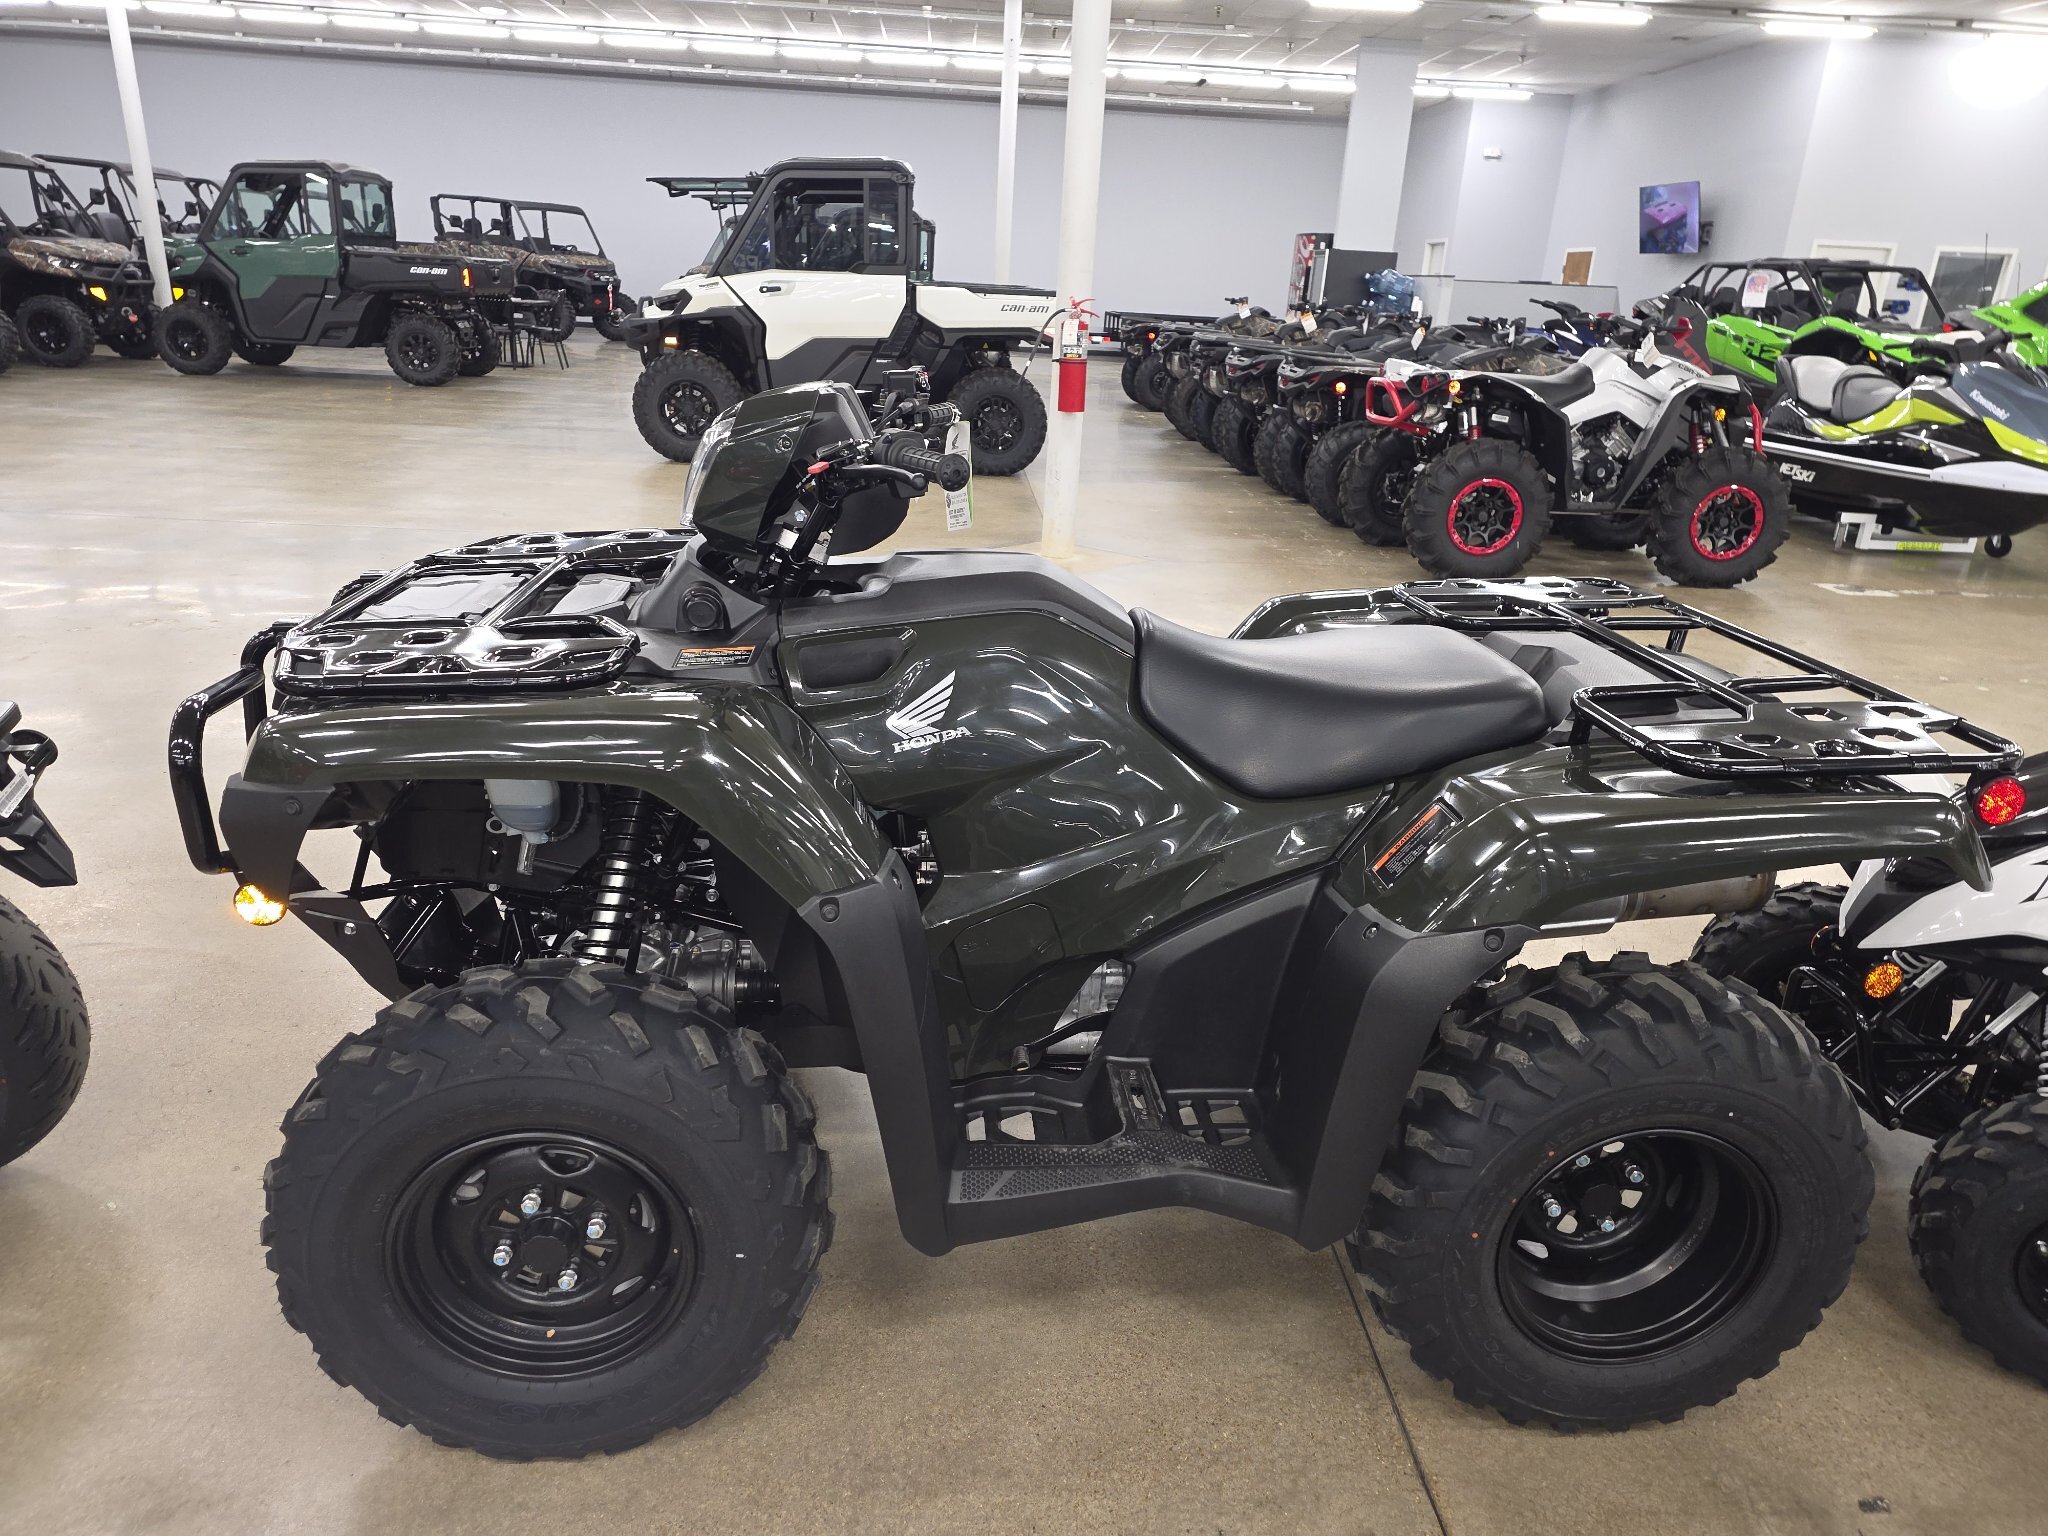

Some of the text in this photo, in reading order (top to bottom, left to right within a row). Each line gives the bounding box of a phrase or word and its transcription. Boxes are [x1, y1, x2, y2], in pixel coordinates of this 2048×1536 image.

[1000, 304, 1050, 313] can-am
[892, 726, 972, 754] HONDA
[1394, 820, 1426, 851] WARNING
